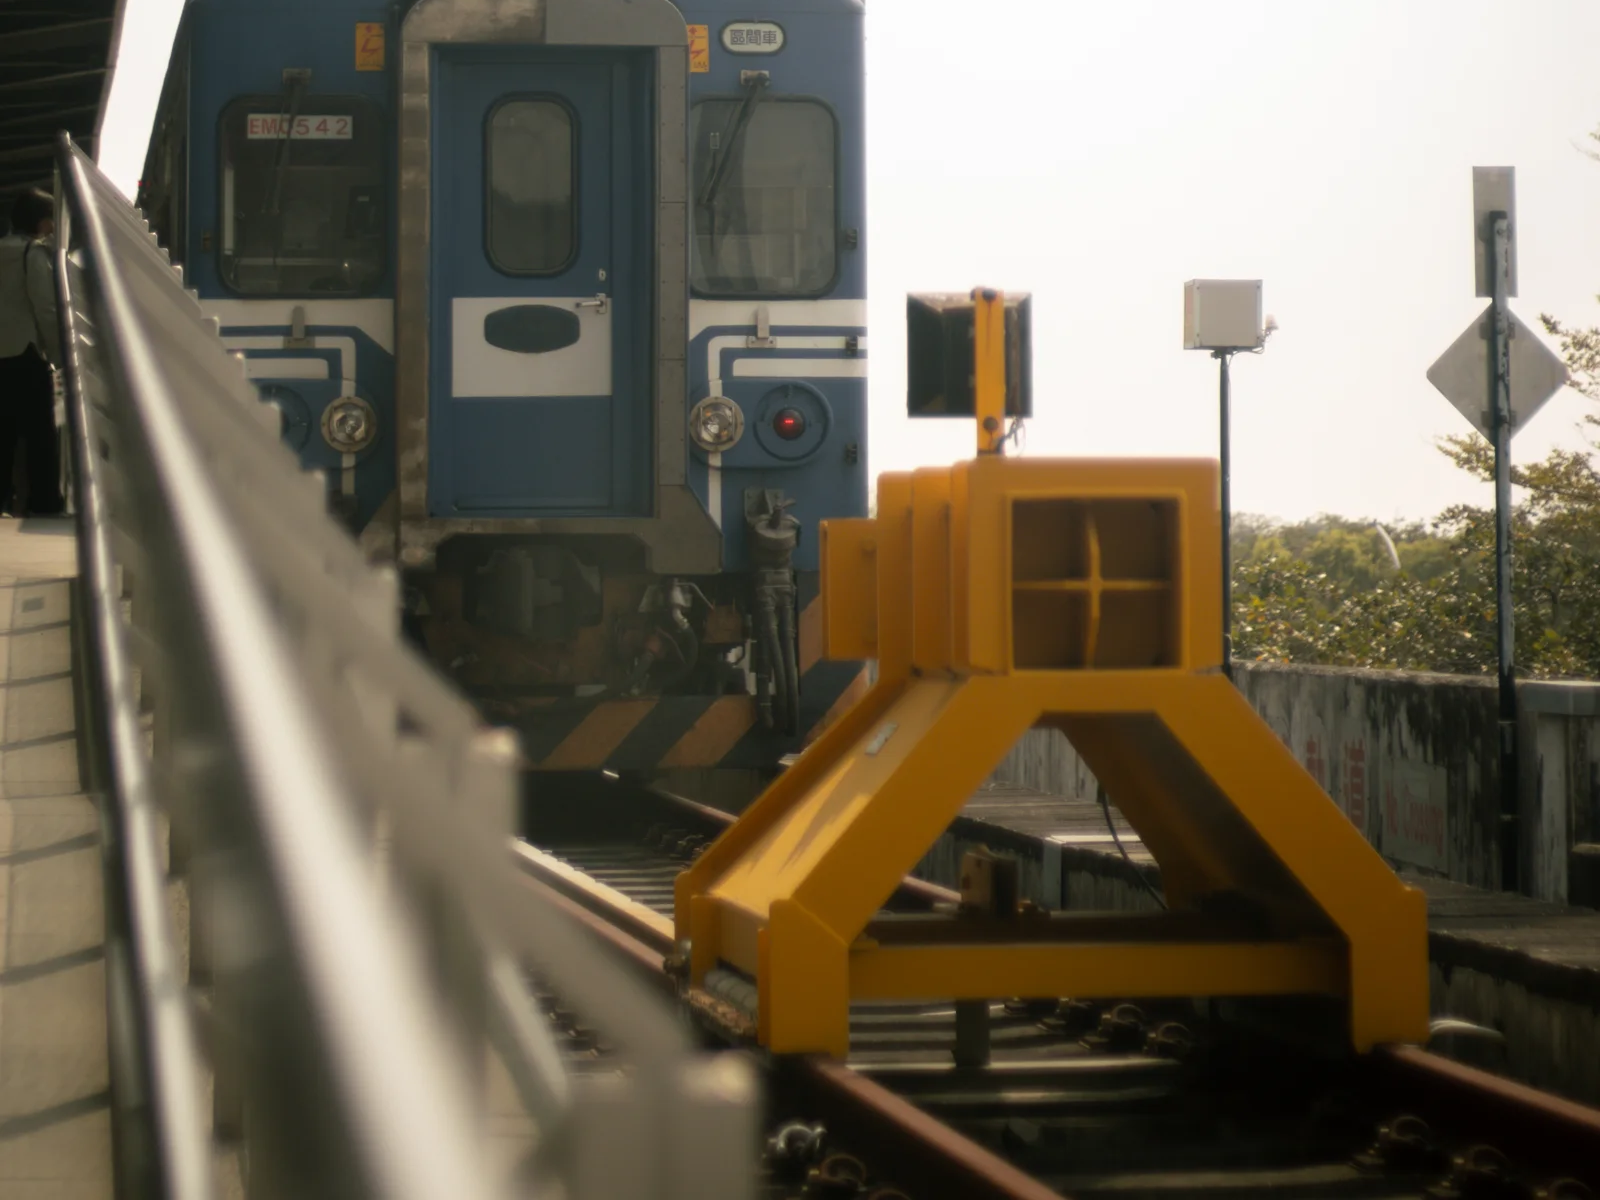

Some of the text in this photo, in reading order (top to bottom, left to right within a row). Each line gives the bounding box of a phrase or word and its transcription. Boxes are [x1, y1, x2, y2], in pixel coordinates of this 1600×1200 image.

[729, 29, 778, 46] 區間車
[1385, 781, 1444, 857] No Crossing
